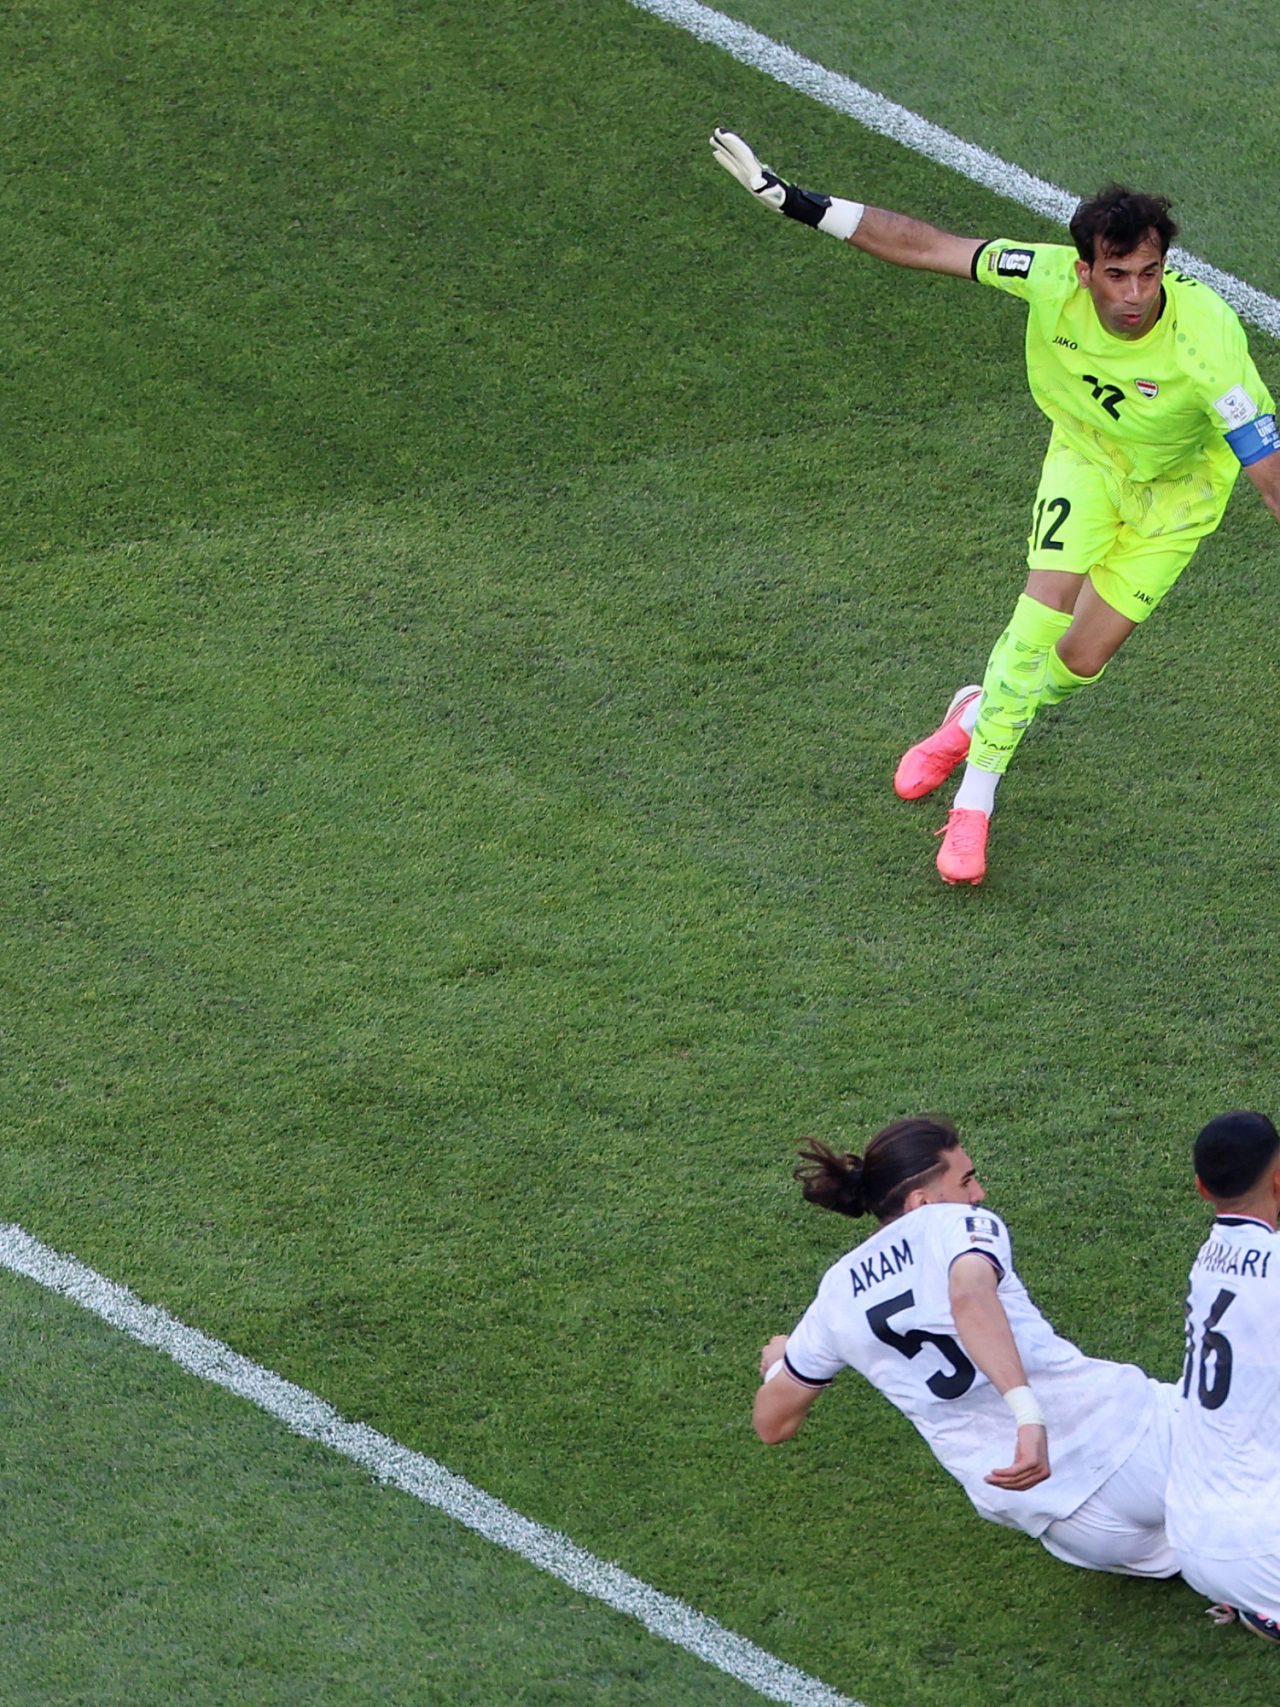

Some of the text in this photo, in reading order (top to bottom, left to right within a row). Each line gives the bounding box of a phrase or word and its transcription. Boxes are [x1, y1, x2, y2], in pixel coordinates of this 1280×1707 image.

[1052, 336, 1078, 350] JAKO
[1033, 497, 1071, 551] 12
[850, 1239, 914, 1298] AKAM
[866, 1289, 976, 1400] 5
